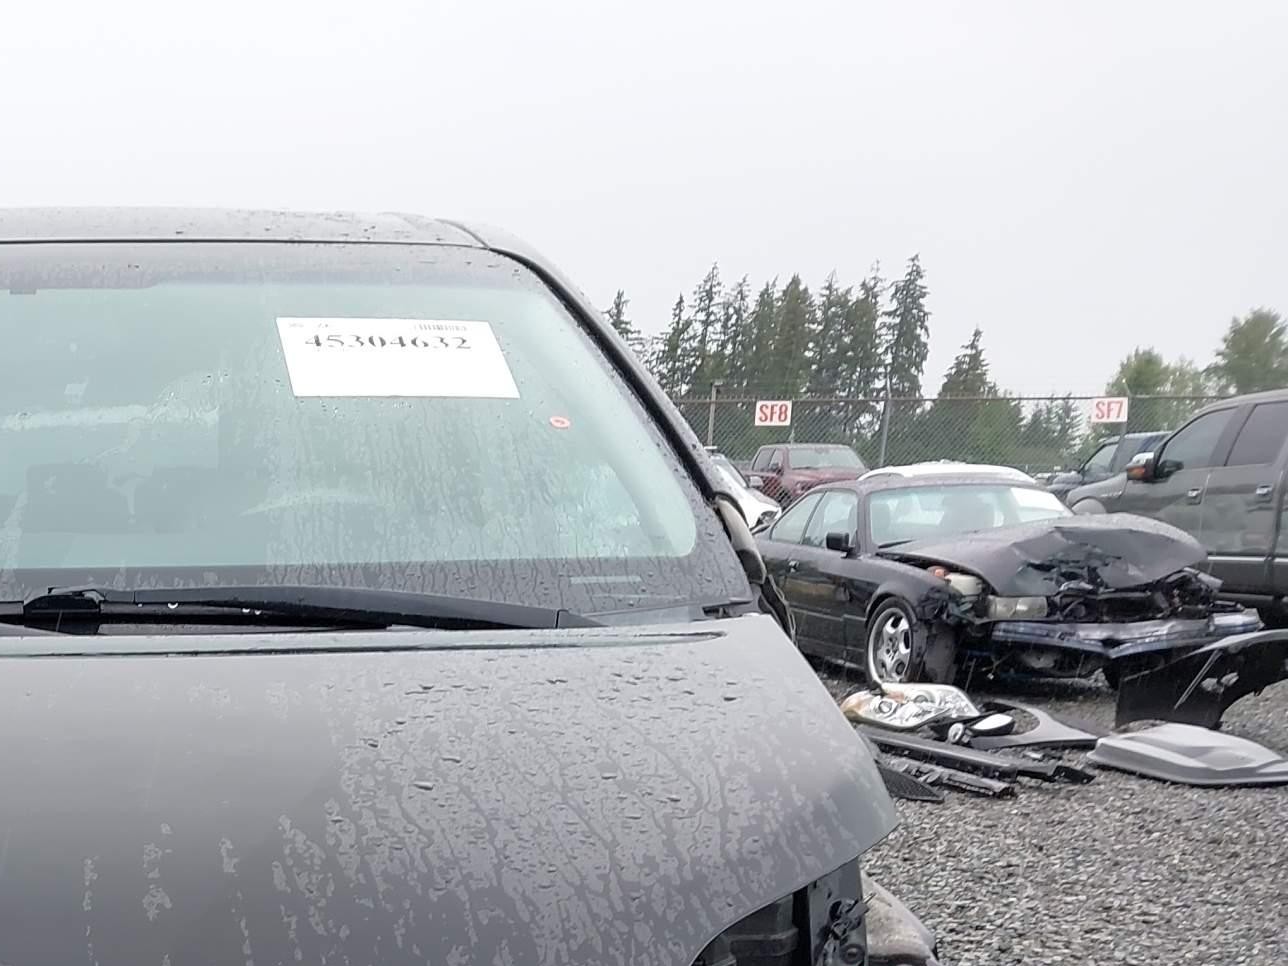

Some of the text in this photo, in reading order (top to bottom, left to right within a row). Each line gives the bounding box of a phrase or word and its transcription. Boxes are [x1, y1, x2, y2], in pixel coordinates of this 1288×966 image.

[305, 335, 471, 350] 45304632
[759, 404, 788, 422] SF8
[1096, 401, 1123, 419] SF7
